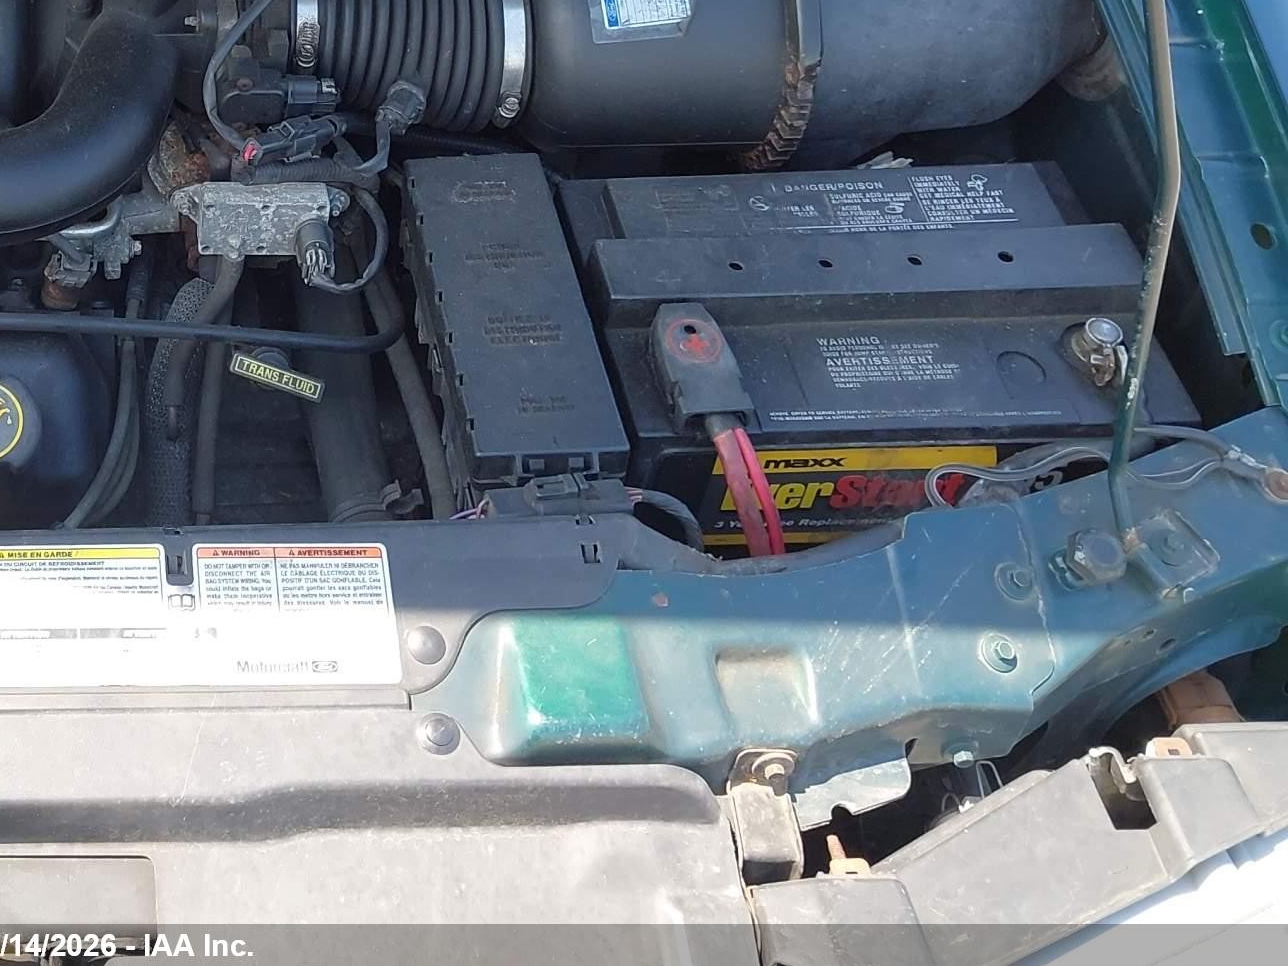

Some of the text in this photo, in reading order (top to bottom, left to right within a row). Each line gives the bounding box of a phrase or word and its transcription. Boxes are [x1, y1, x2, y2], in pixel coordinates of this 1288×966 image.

[816, 336, 880, 346] WARNING
[242, 360, 316, 394] TRANS FLUID
[764, 457, 847, 469] maxx
